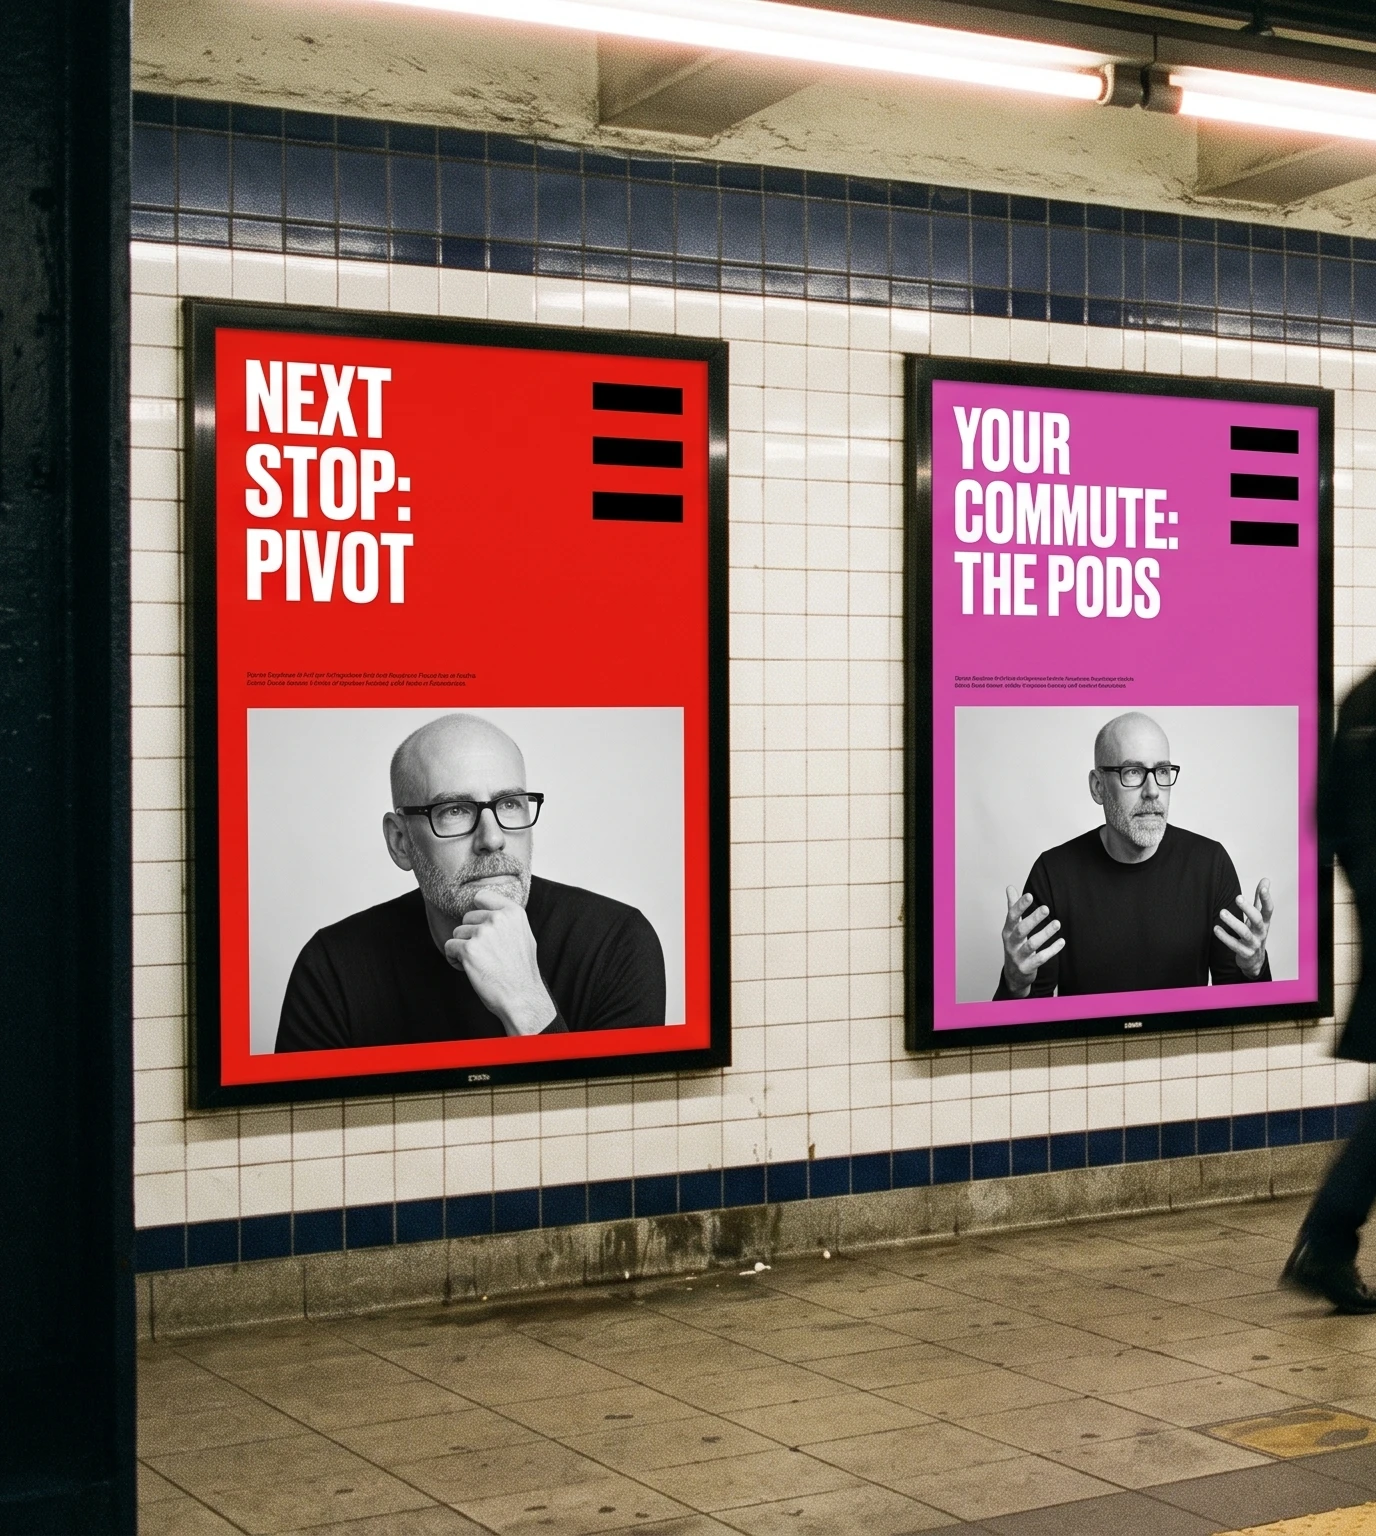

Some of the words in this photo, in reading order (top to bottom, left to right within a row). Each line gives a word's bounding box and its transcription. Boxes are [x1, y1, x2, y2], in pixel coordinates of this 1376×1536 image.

[246, 360, 392, 439] NEXT
[953, 407, 1071, 476] YOUR
[246, 444, 411, 522] STOP:
[954, 478, 1179, 551] COMMUTE:
[247, 529, 414, 604] PIVOT
[954, 552, 1038, 616] THE
[1049, 554, 1161, 620] PODS
